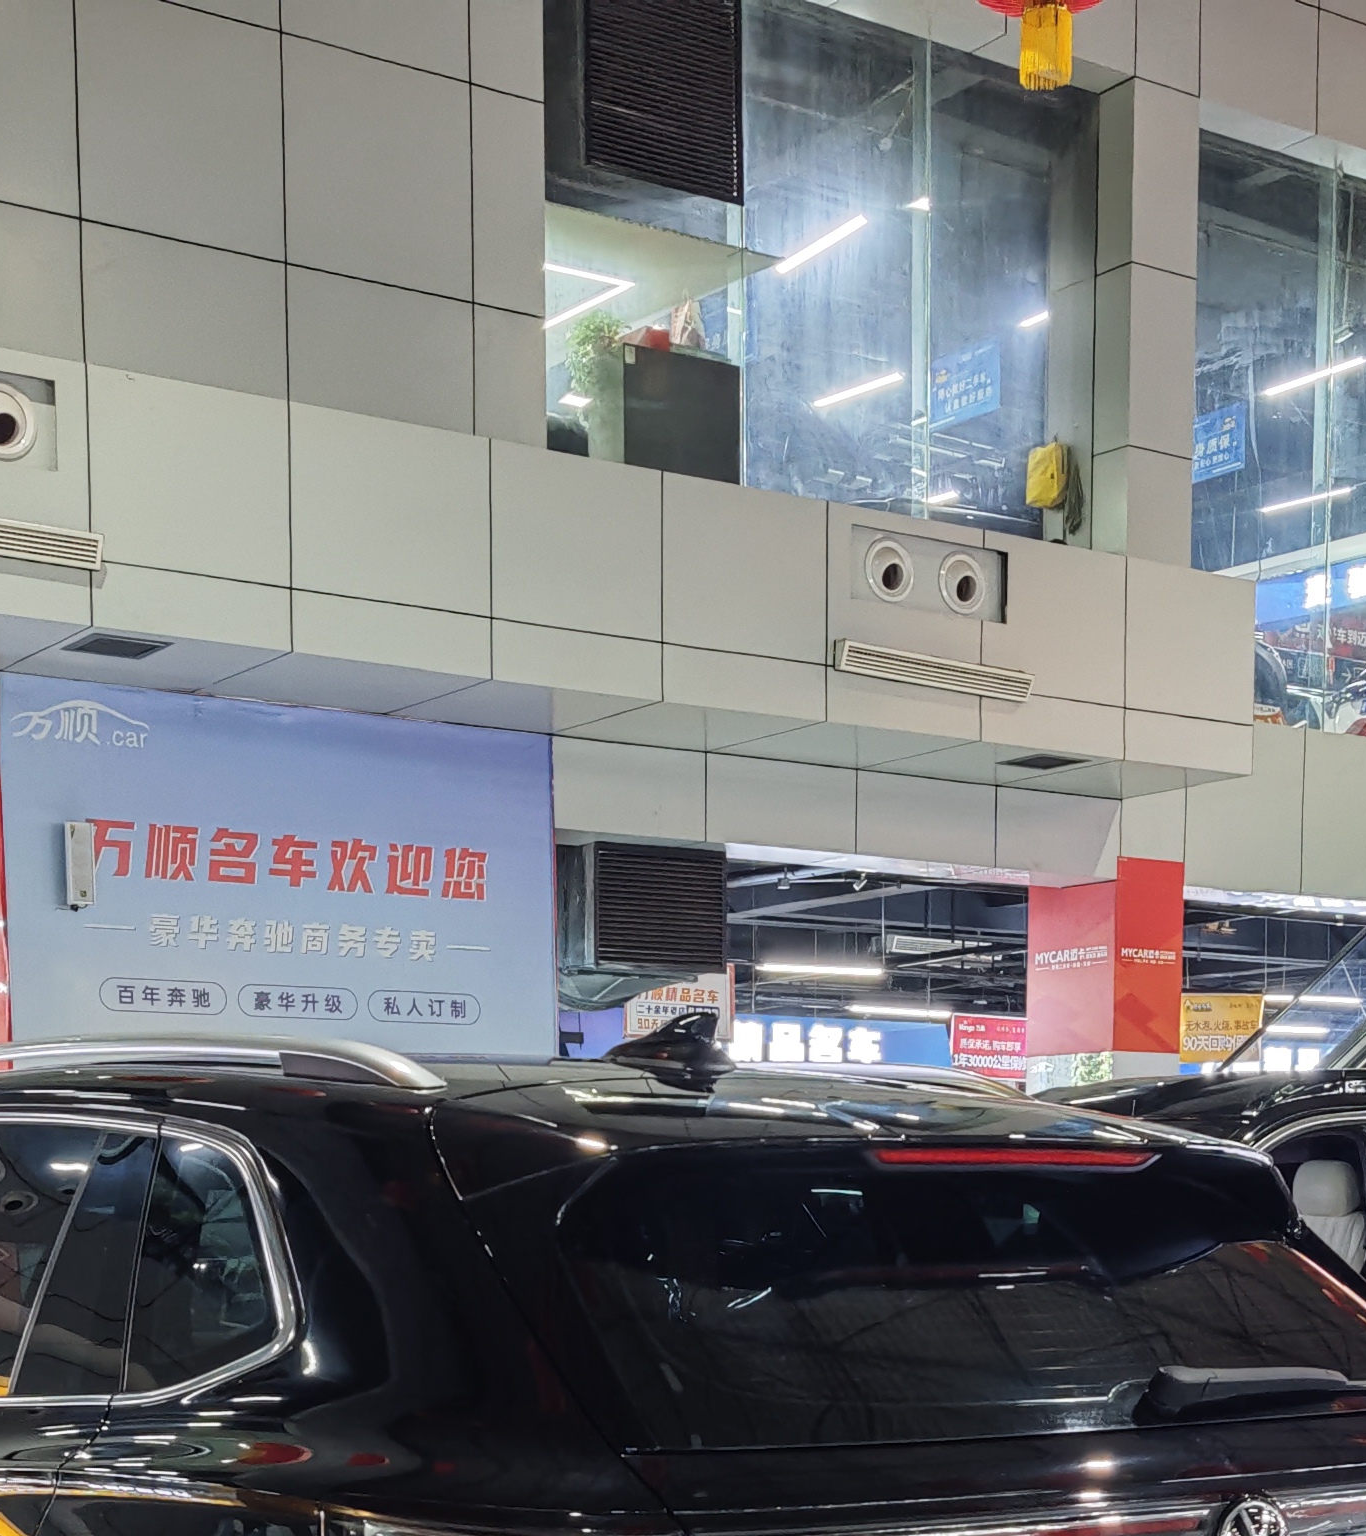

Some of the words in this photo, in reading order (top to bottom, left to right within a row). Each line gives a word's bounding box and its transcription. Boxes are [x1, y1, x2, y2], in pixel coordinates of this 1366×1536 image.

[85, 816, 489, 901] 万顺名车欢迎您
[148, 913, 438, 962] 豪华奔驰商务专卖
[115, 983, 212, 1009] 百年奔驰
[252, 990, 344, 1015] 豪华升级
[382, 995, 468, 1020] 私人订制
